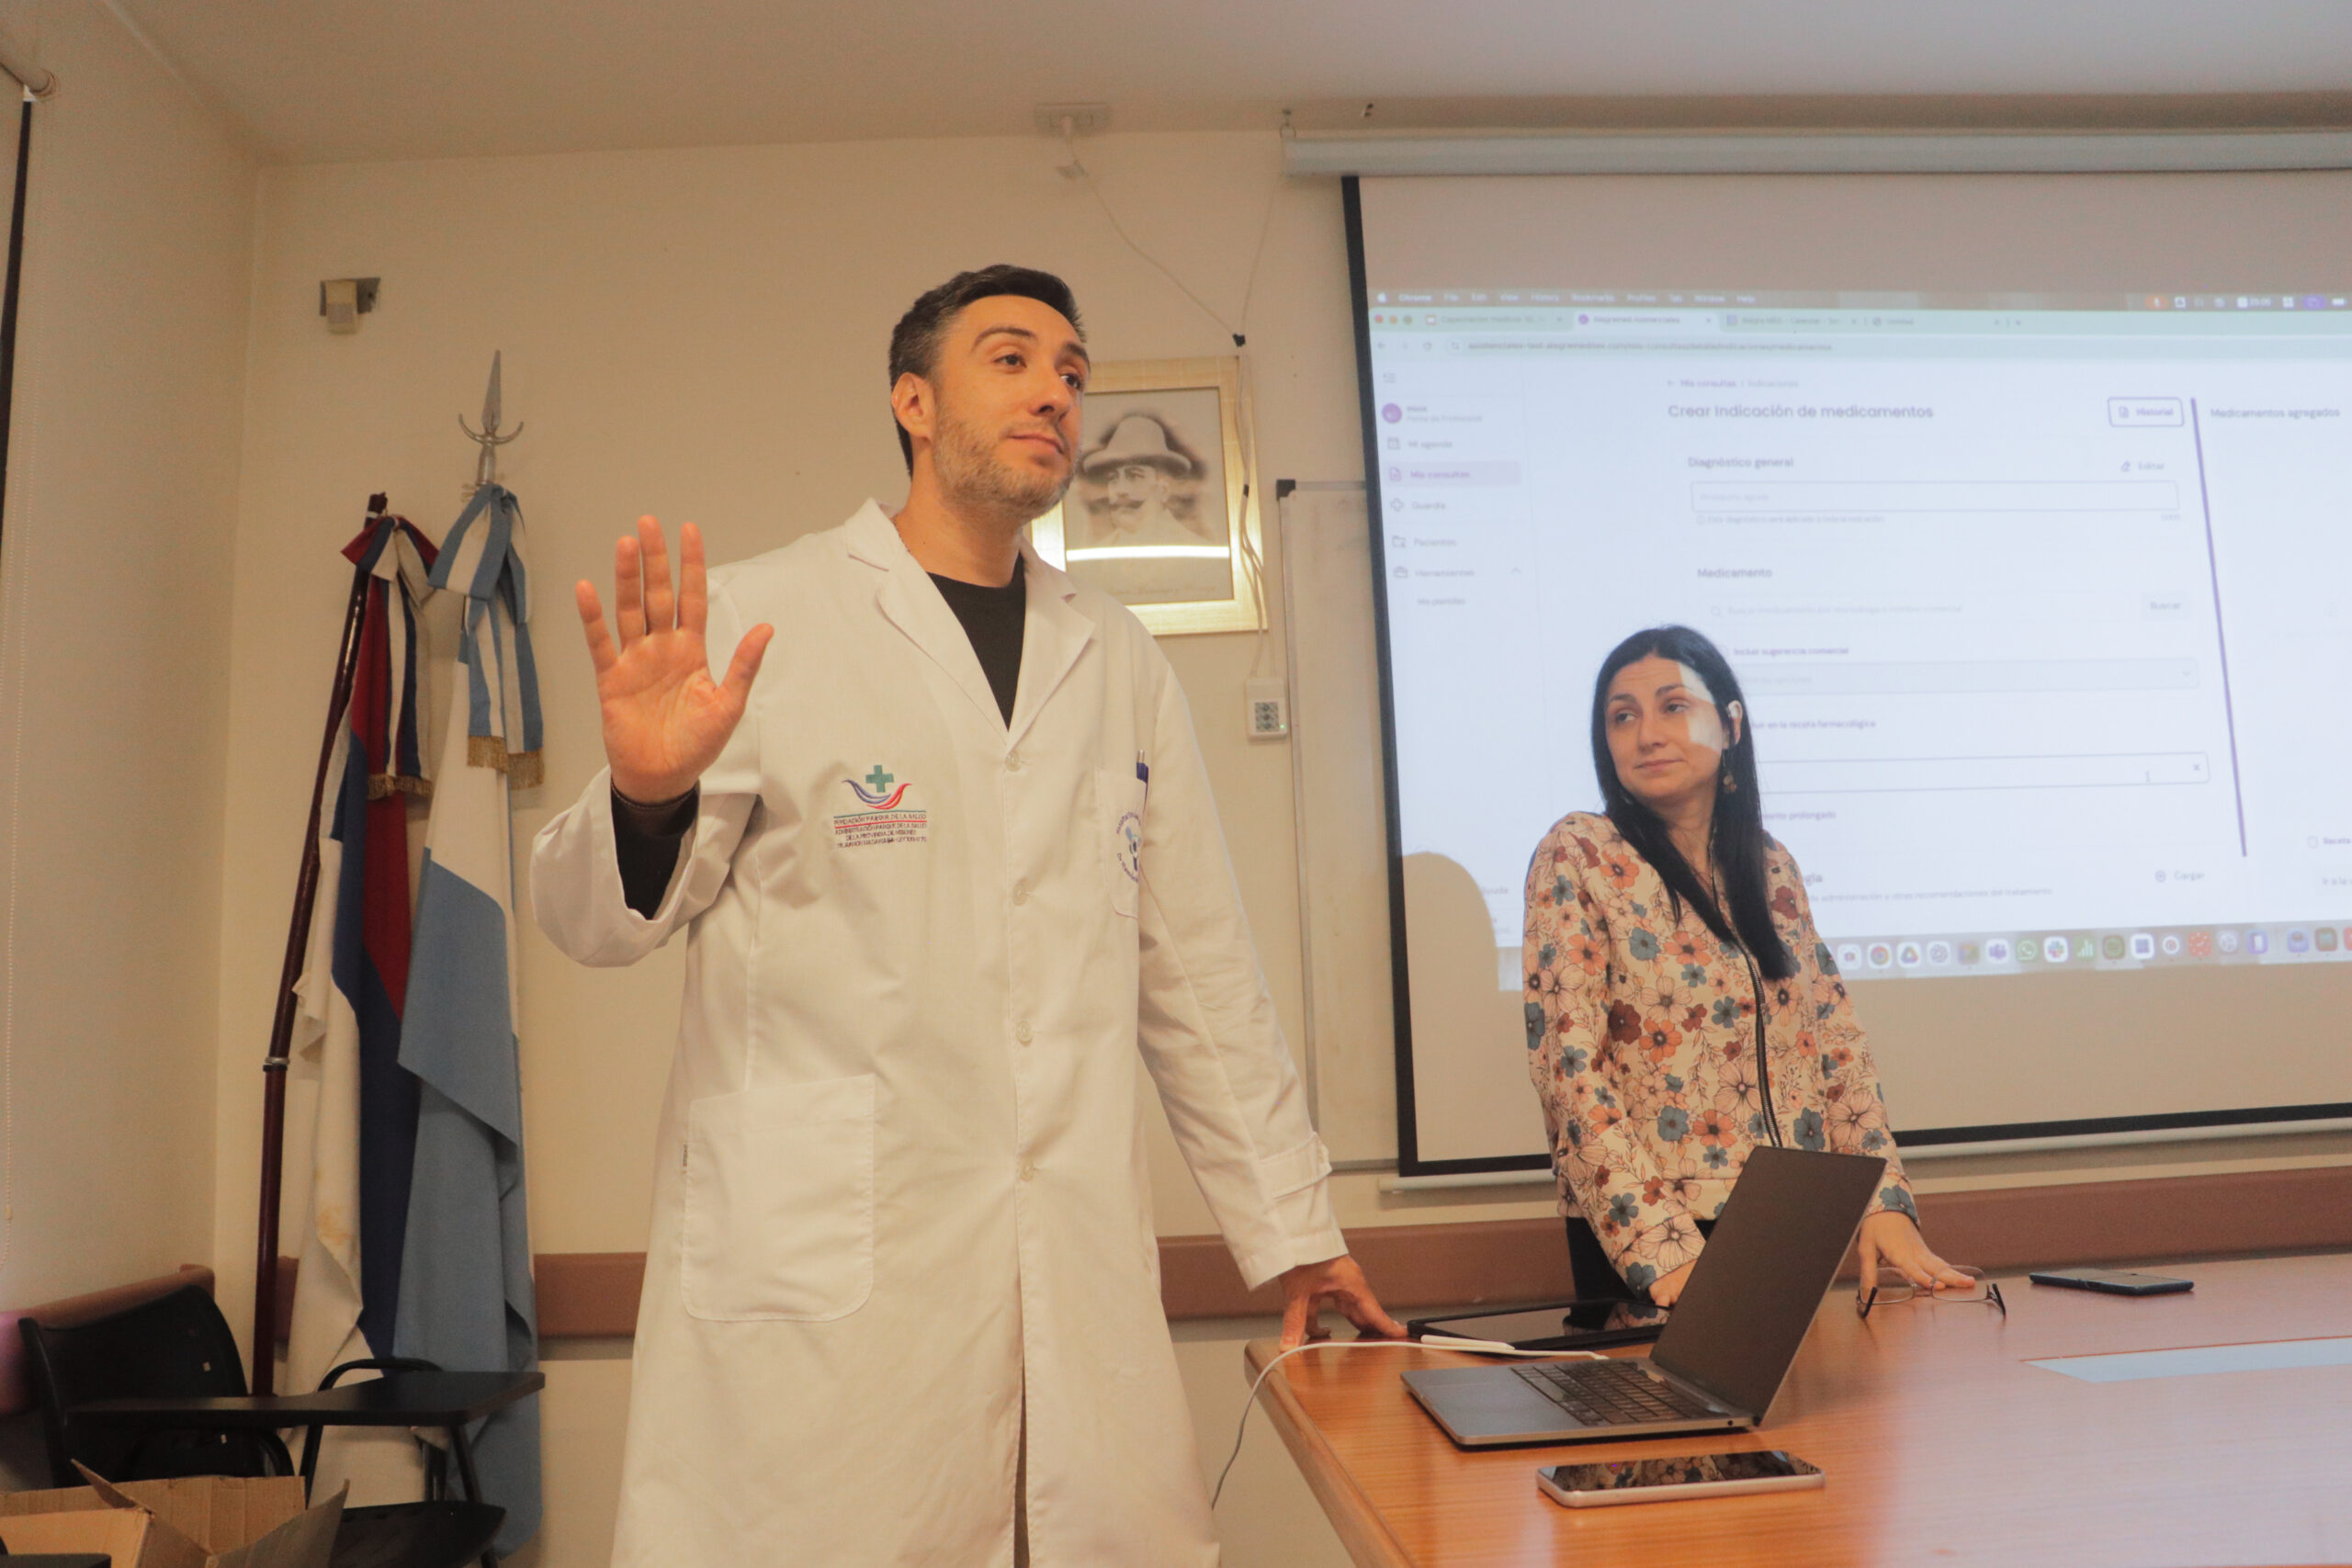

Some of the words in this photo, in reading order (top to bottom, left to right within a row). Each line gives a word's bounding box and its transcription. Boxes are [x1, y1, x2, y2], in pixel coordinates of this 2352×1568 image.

[1668, 404, 1710, 418] Crear
[1714, 402, 1794, 418] Indicación
[1797, 405, 1817, 418] de
[1820, 404, 1934, 418] medicamentos
[2135, 406, 2175, 417] Historial
[2211, 408, 2285, 419] Medicamentos
[2287, 407, 2340, 421] agregados
[1688, 456, 1751, 469] Diagnóstico
[1754, 457, 1794, 469] general
[1697, 566, 1772, 578] Medicamento
